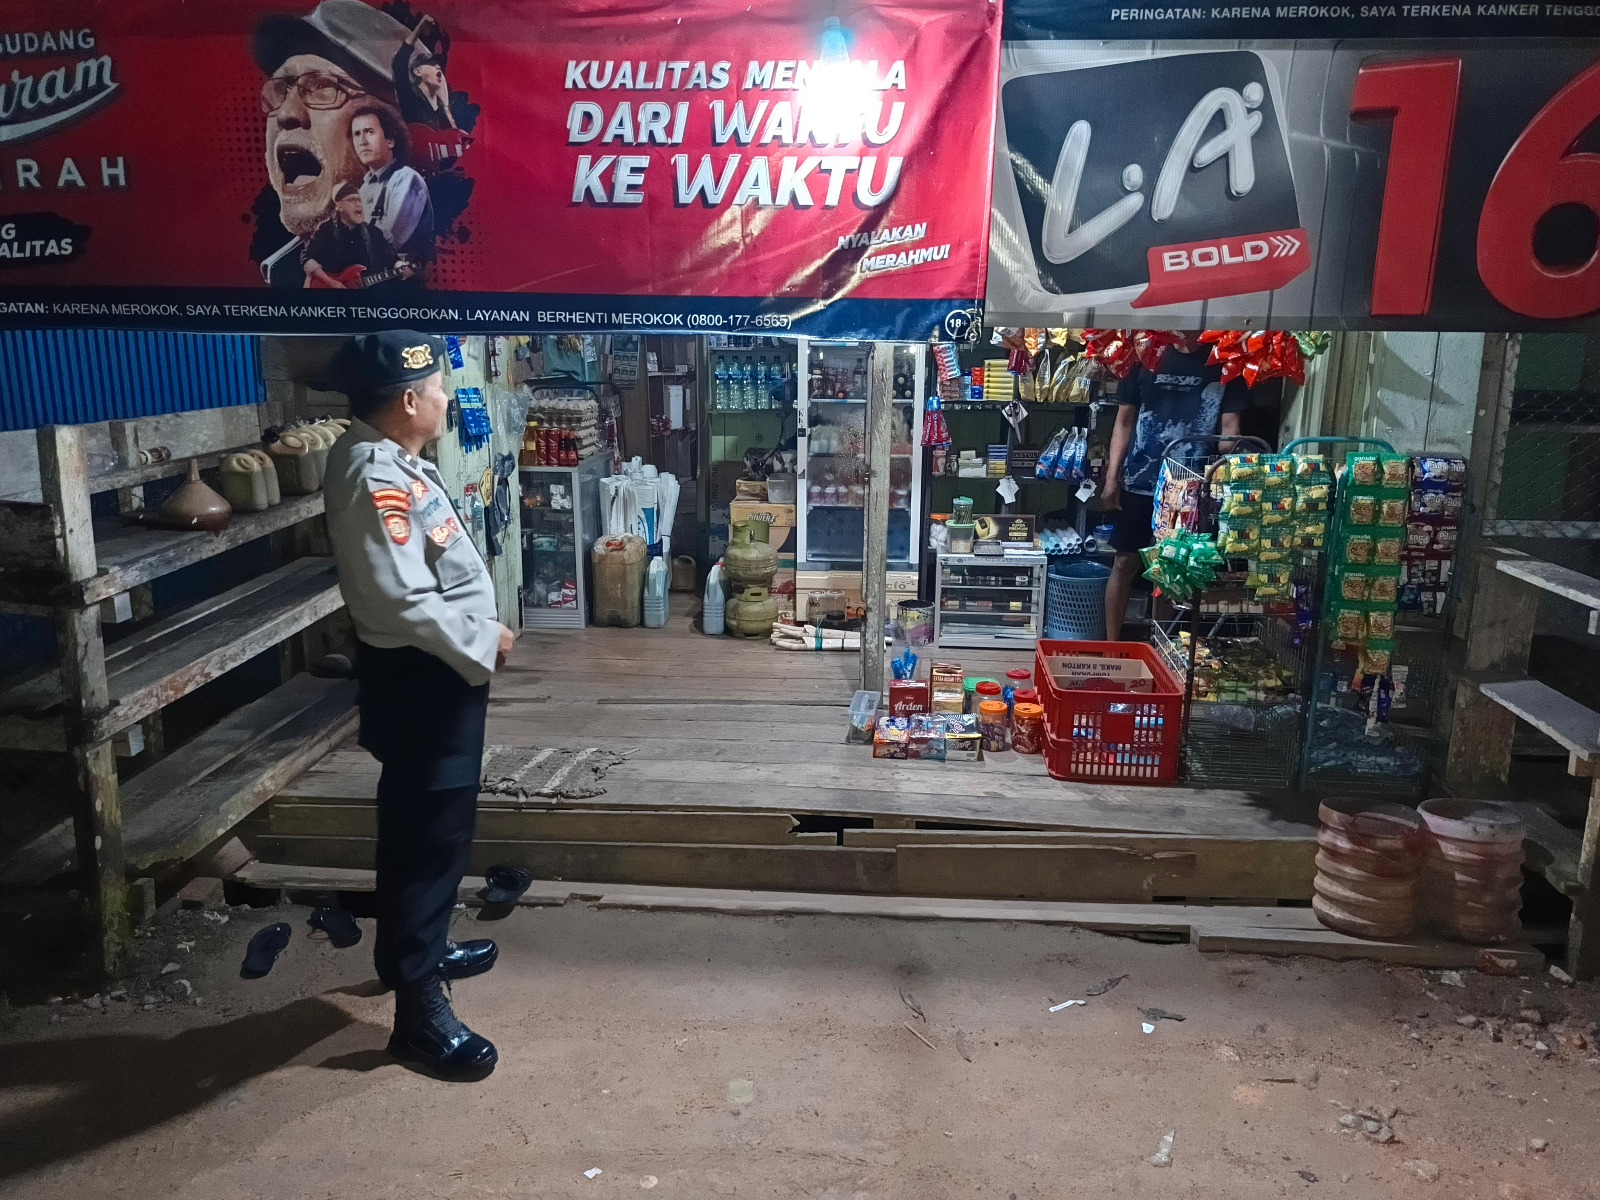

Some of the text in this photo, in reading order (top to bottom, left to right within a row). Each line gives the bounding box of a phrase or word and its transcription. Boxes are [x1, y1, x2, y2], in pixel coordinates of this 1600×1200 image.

[1111, 8, 1206, 20] PERINGATAN:
[1211, 6, 1271, 19] KARENA
[1276, 5, 1355, 19] MEROKOK,
[1360, 5, 1396, 17] SAYA
[1402, 4, 1471, 17] TERKENA
[1477, 4, 1539, 16] KANKER
[0, 28, 95, 54] UDANG
[565, 59, 906, 90] KUALITAS MENLA
[566, 100, 690, 146] DARI
[571, 154, 904, 208] KE WAKTU
[1349, 55, 1600, 320] 16
[838, 222, 927, 250] NYALAKAN
[861, 244, 951, 272] MERAHMU!
[1162, 239, 1270, 273] BOLD
[53, 303, 109, 315] KARENA
[112, 303, 183, 317] MEROKOK,
[186, 304, 221, 316] SAYA
[223, 305, 288, 317] TERKENA
[291, 306, 347, 318] KANKER
[350, 306, 463, 321] TENGGOROKAN.
[466, 309, 530, 322] LAYANAN
[537, 311, 607, 324] BERHENTI
[611, 312, 683, 325] MEROKOK
[686, 313, 792, 330] (0800-177-6565)
[950, 318, 968, 328] 18+
[1062, 662, 1091, 670] KARTON
[893, 700, 924, 712] Arden
